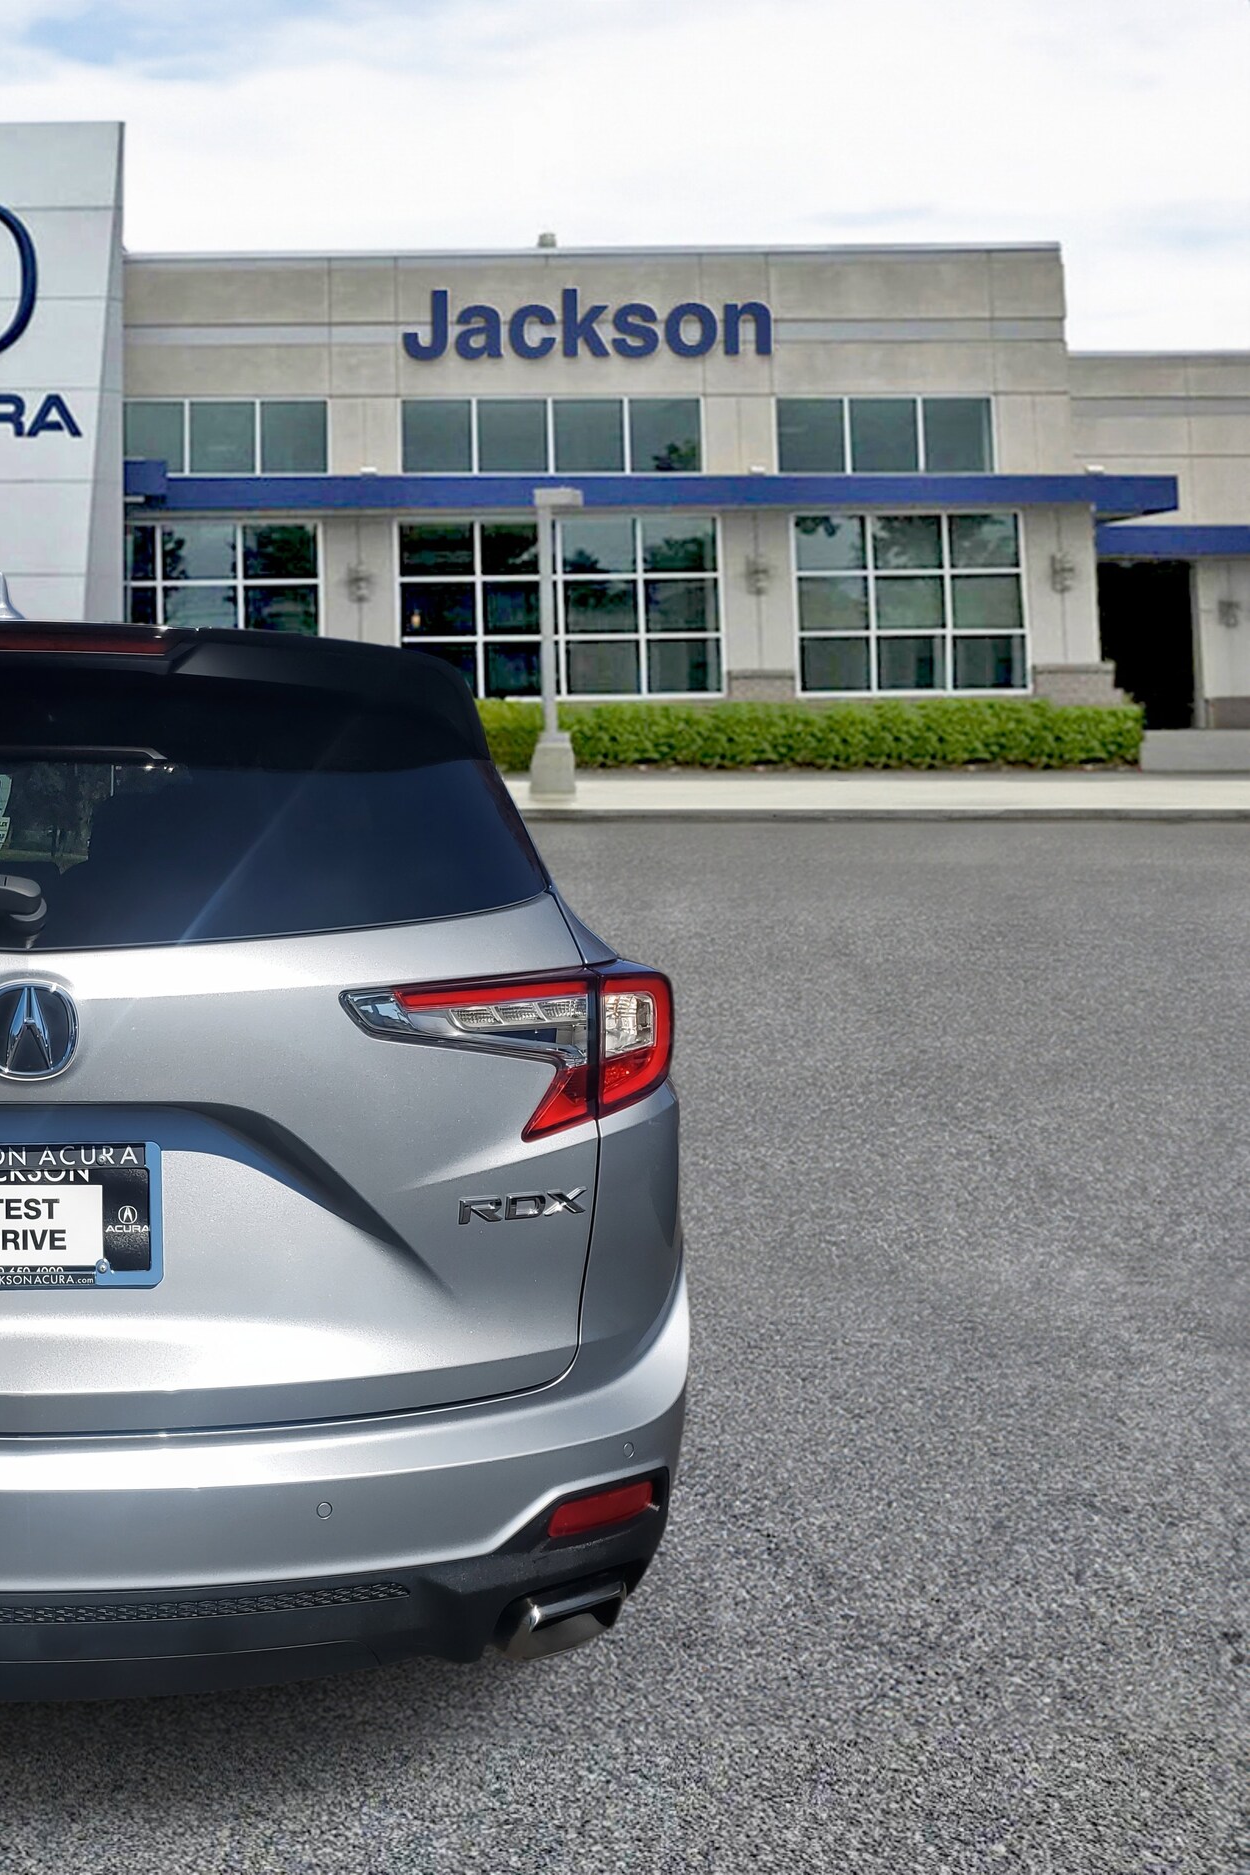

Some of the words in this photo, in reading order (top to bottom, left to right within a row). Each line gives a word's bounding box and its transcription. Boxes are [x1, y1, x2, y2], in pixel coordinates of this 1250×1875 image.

[402, 288, 773, 362] Jackson
[38, 1145, 139, 1166] ACURA
[458, 1186, 587, 1225] RDX
[105, 1224, 150, 1233] ACURA
